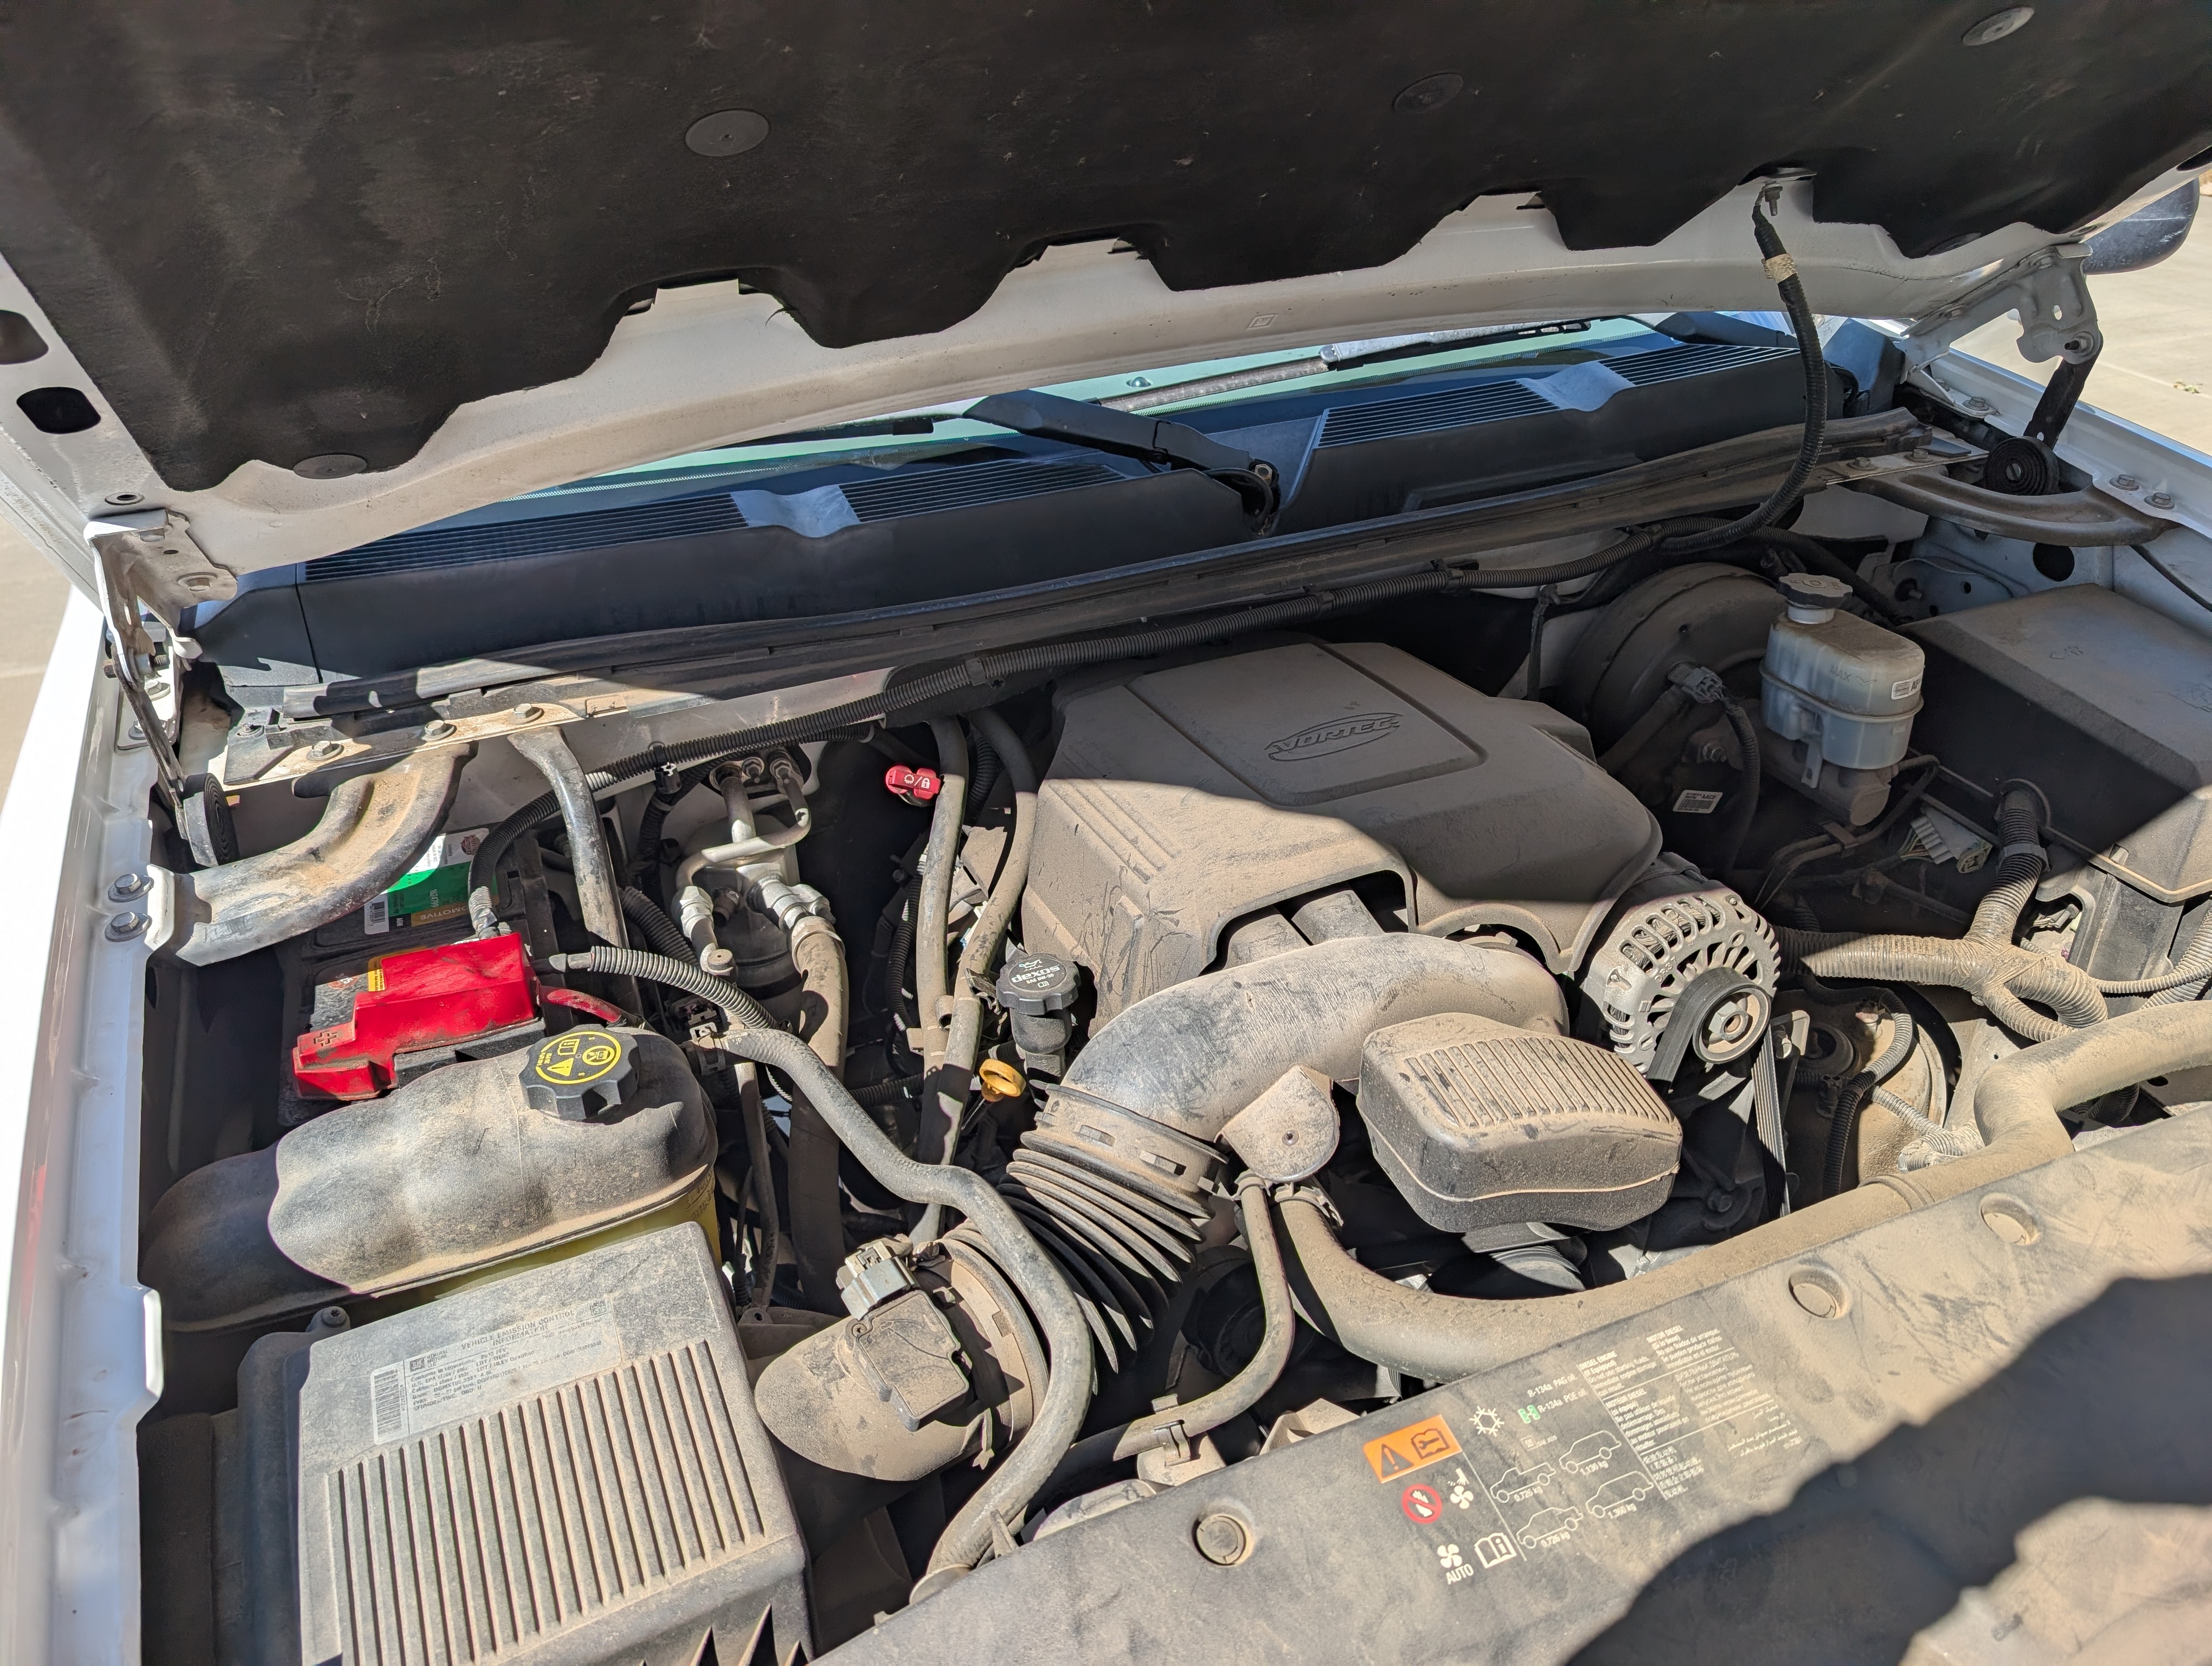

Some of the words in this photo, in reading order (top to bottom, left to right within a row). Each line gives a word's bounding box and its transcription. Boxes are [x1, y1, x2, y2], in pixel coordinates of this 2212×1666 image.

[1274, 717, 1400, 751] VORTEC
[430, 889, 439, 907] 1624799
[420, 905, 468, 920] OMOTIVE
[1011, 965, 1060, 983] dexos
[461, 1335, 494, 1350] VEHICLE
[497, 1321, 536, 1338] EMISSION
[539, 1310, 575, 1325] CONTROL
[493, 1324, 548, 1346] INFORMATION
[1647, 1331, 1666, 1343] MOTOR
[428, 1354, 447, 1363] MOTORS
[1579, 1359, 1598, 1370] DIESEL
[1597, 1350, 1618, 1363] ENGINE
[411, 1371, 436, 1382] Conforms
[439, 1377, 453, 1385] class
[1527, 1383, 1553, 1398] R-134a
[1553, 1376, 1568, 1387] PAG
[1537, 1399, 1563, 1413] R-134a
[1563, 1392, 1578, 1403] POE
[1605, 1395, 1629, 1408] MOTEUR
[1627, 1388, 1647, 1400] DIESEL
[1599, 1460, 1609, 1470] kg
[1533, 1486, 1544, 1495] kg
[1627, 1503, 1637, 1512] kg
[1560, 1532, 1571, 1541] kg
[1445, 1564, 1474, 1585] AUTO
